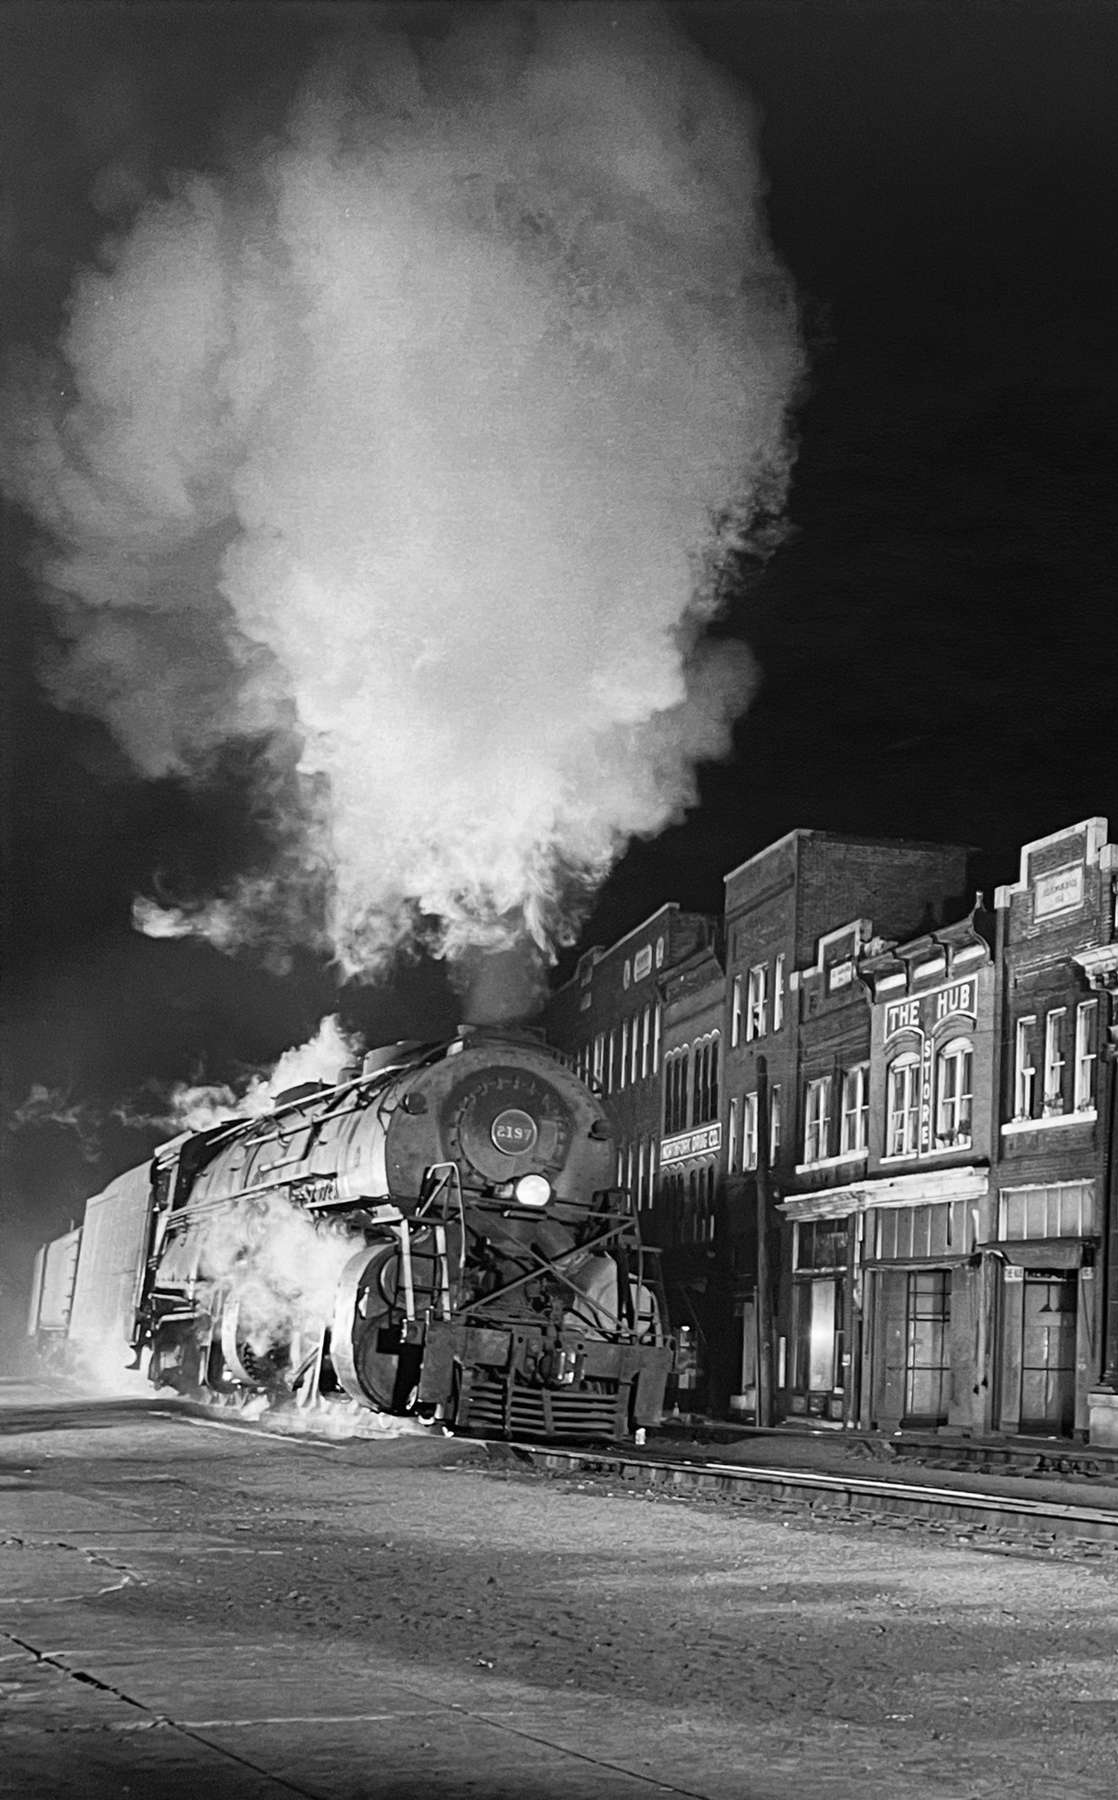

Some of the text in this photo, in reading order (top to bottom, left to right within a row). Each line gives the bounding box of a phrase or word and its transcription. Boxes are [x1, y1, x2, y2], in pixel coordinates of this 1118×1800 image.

[889, 984, 970, 1031] THE HUB
[922, 1040, 931, 1144] STORE
